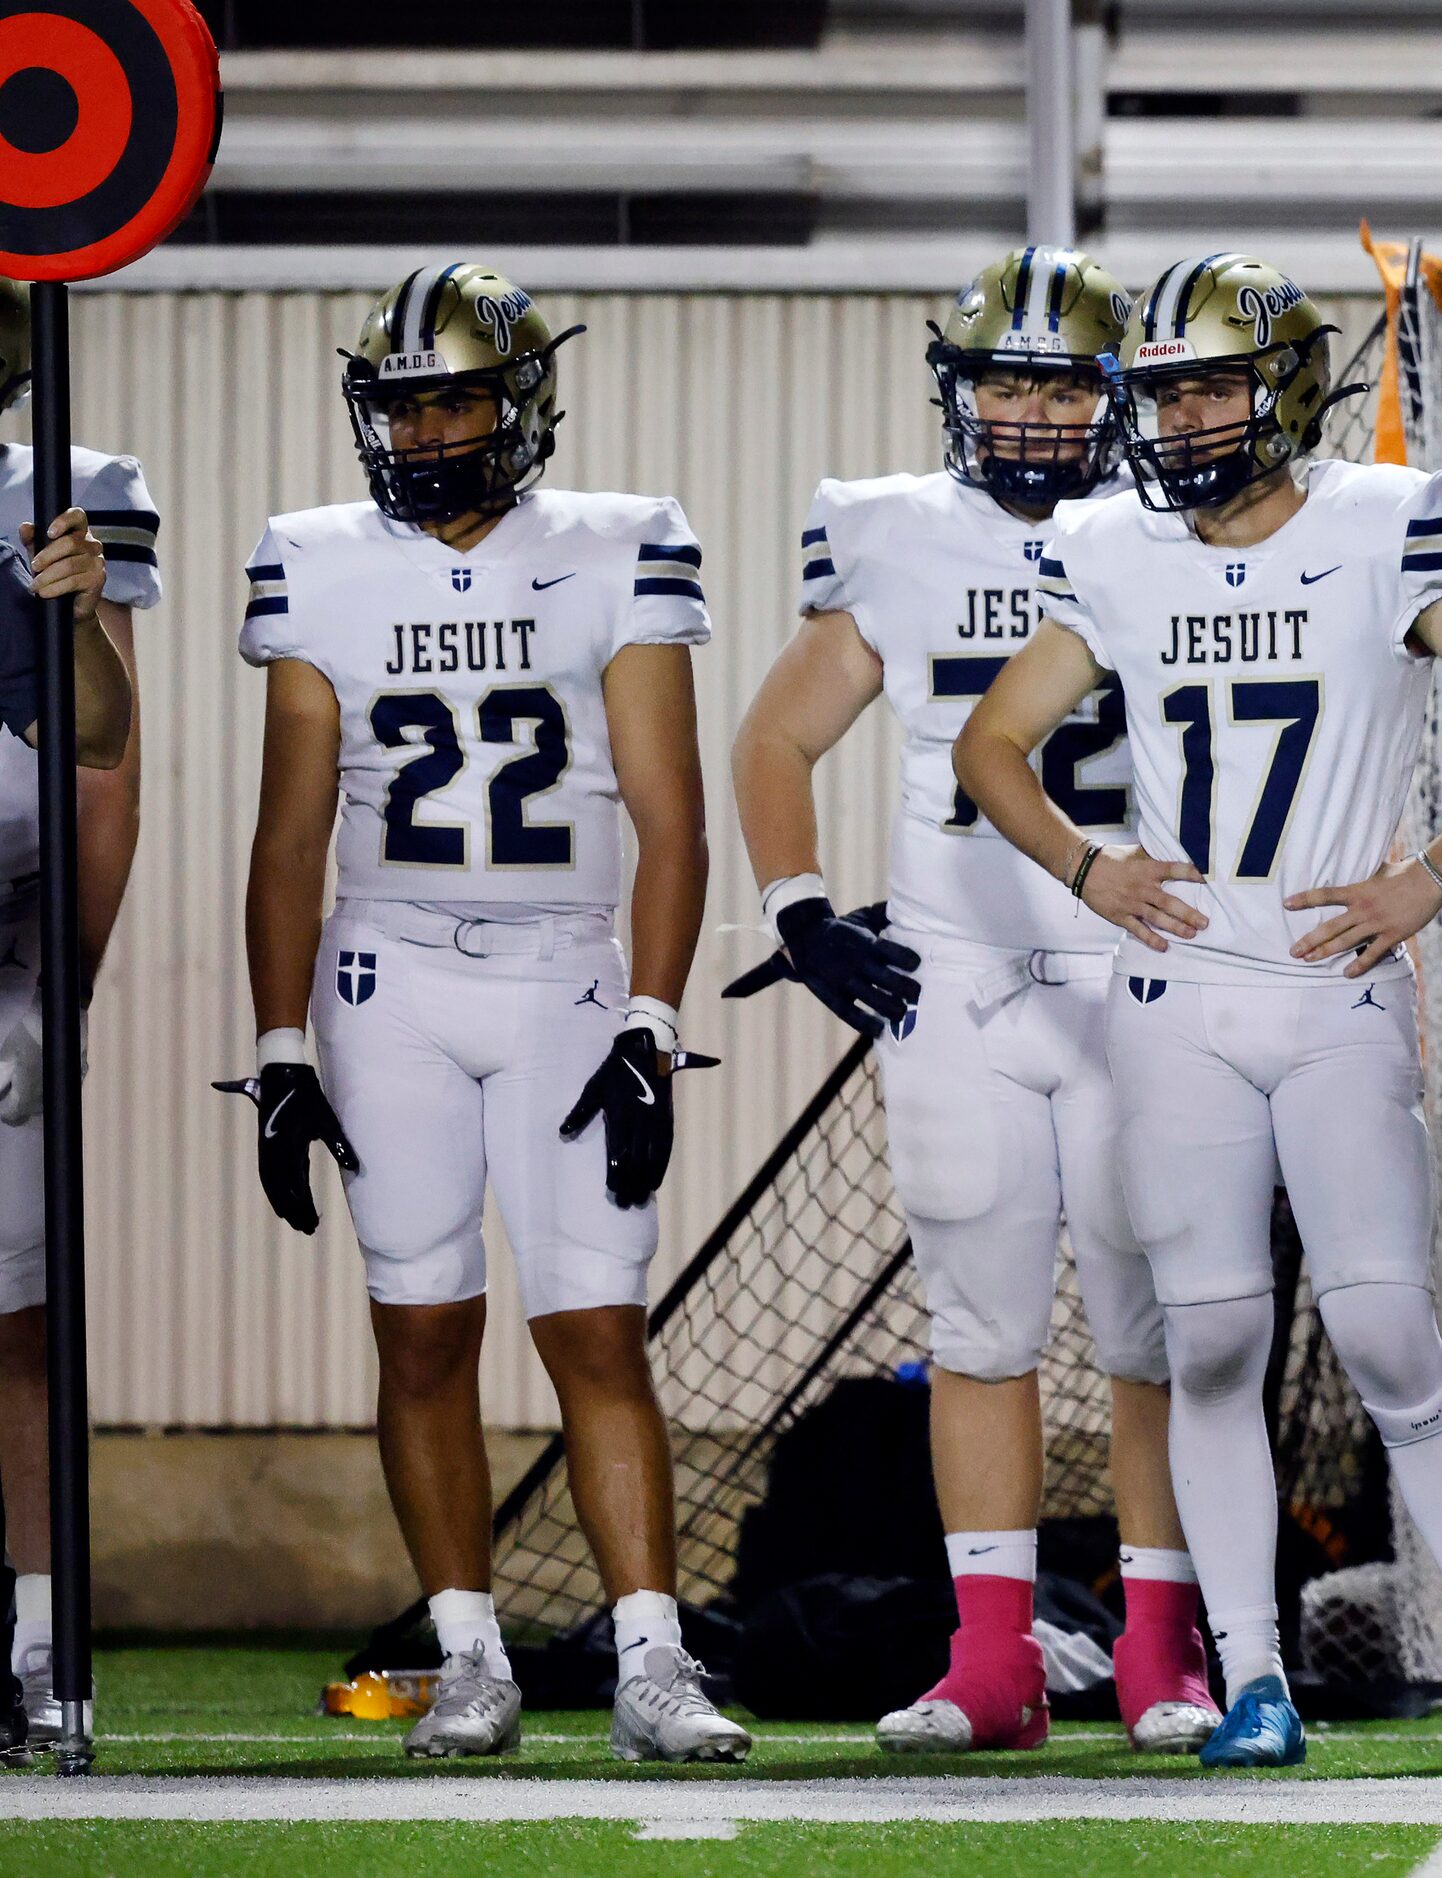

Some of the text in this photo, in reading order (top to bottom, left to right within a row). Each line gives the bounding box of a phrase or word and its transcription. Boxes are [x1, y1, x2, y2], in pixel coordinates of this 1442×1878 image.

[1139, 343, 1185, 359] Riddell
[958, 589, 1043, 638] JES
[1161, 610, 1308, 664] JESUIT
[386, 619, 536, 675] JESUIT
[365, 681, 576, 872] 22
[1158, 672, 1325, 884] 17
